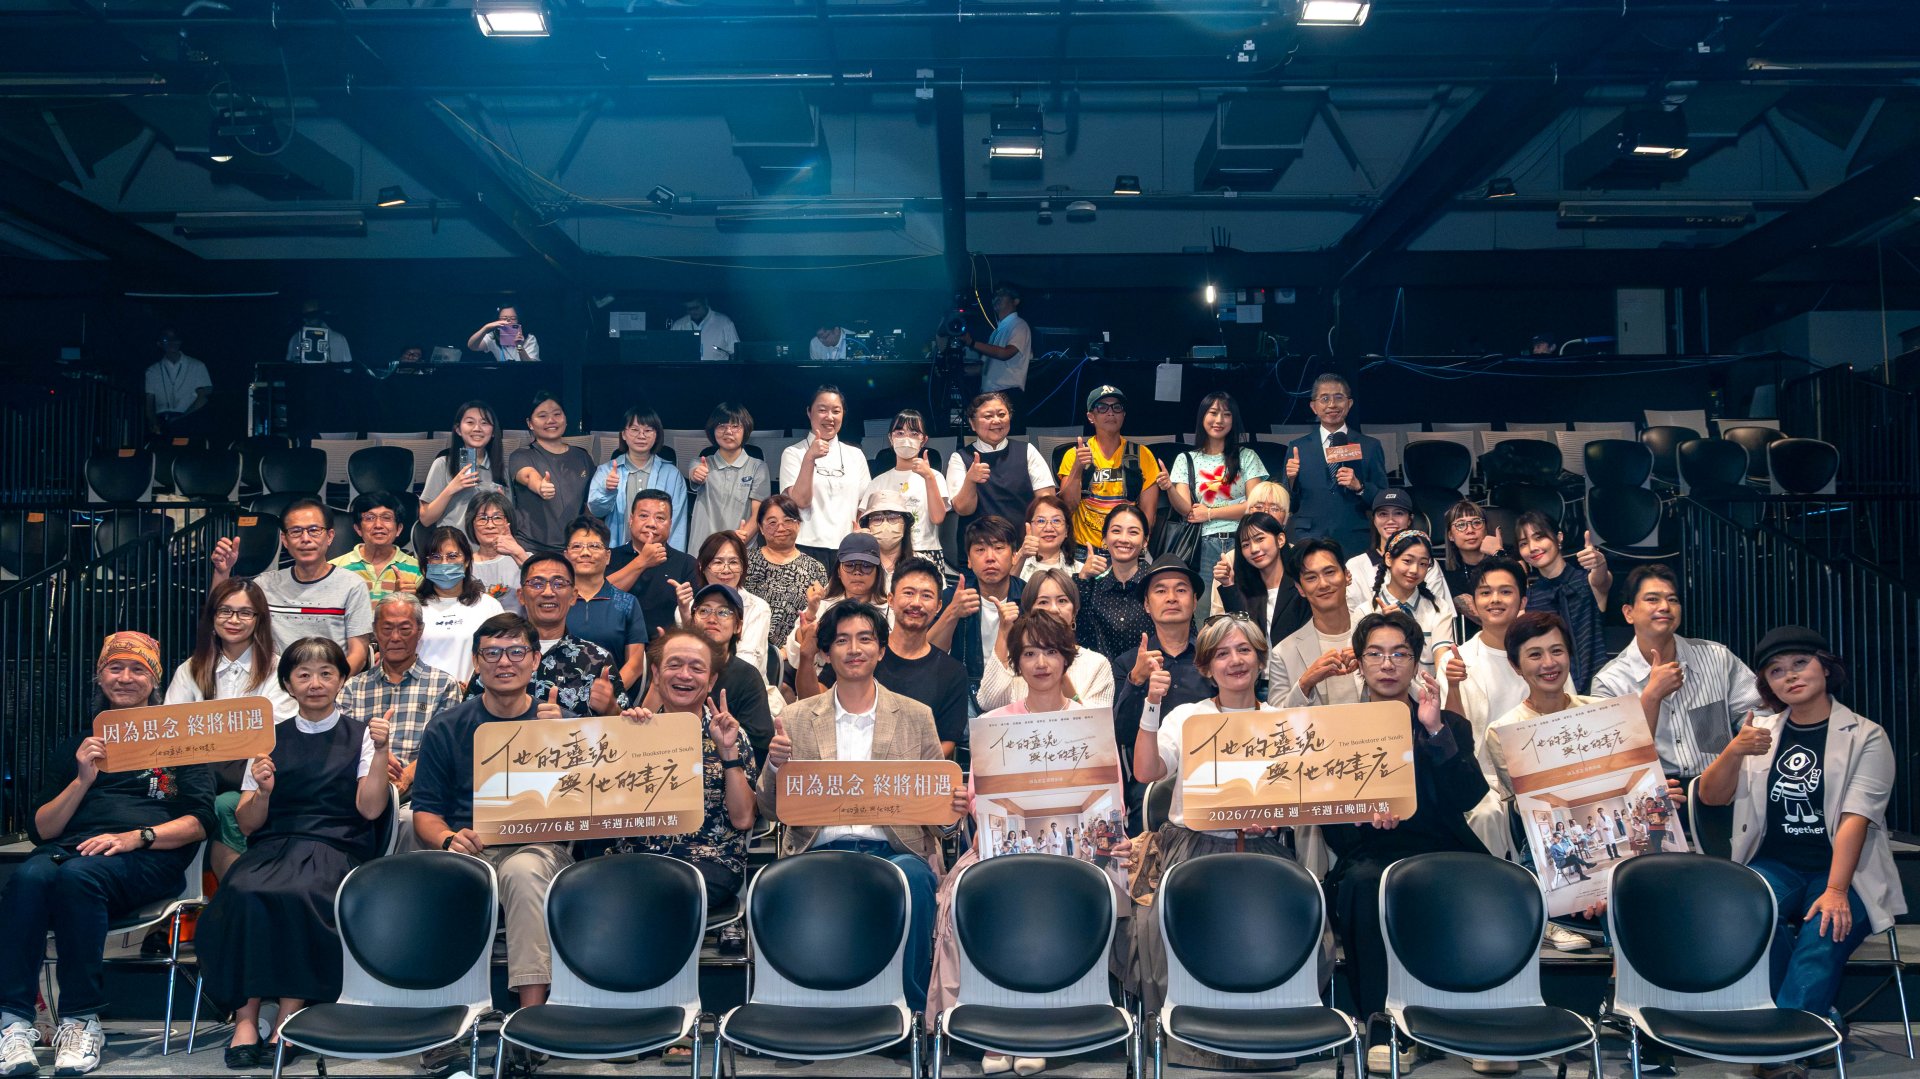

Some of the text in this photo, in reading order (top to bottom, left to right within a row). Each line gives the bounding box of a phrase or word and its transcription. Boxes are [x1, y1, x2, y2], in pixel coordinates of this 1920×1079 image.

[103, 708, 264, 744] 因為思念 終將相遇
[786, 773, 952, 797] 因為思念 終將相遇
[1209, 801, 1390, 821] 2026/7/6起 週一至週五晚間八點
[499, 814, 679, 835] 2026/7/6起 週一至週五晚間八點
[1781, 823, 1825, 836] Together
